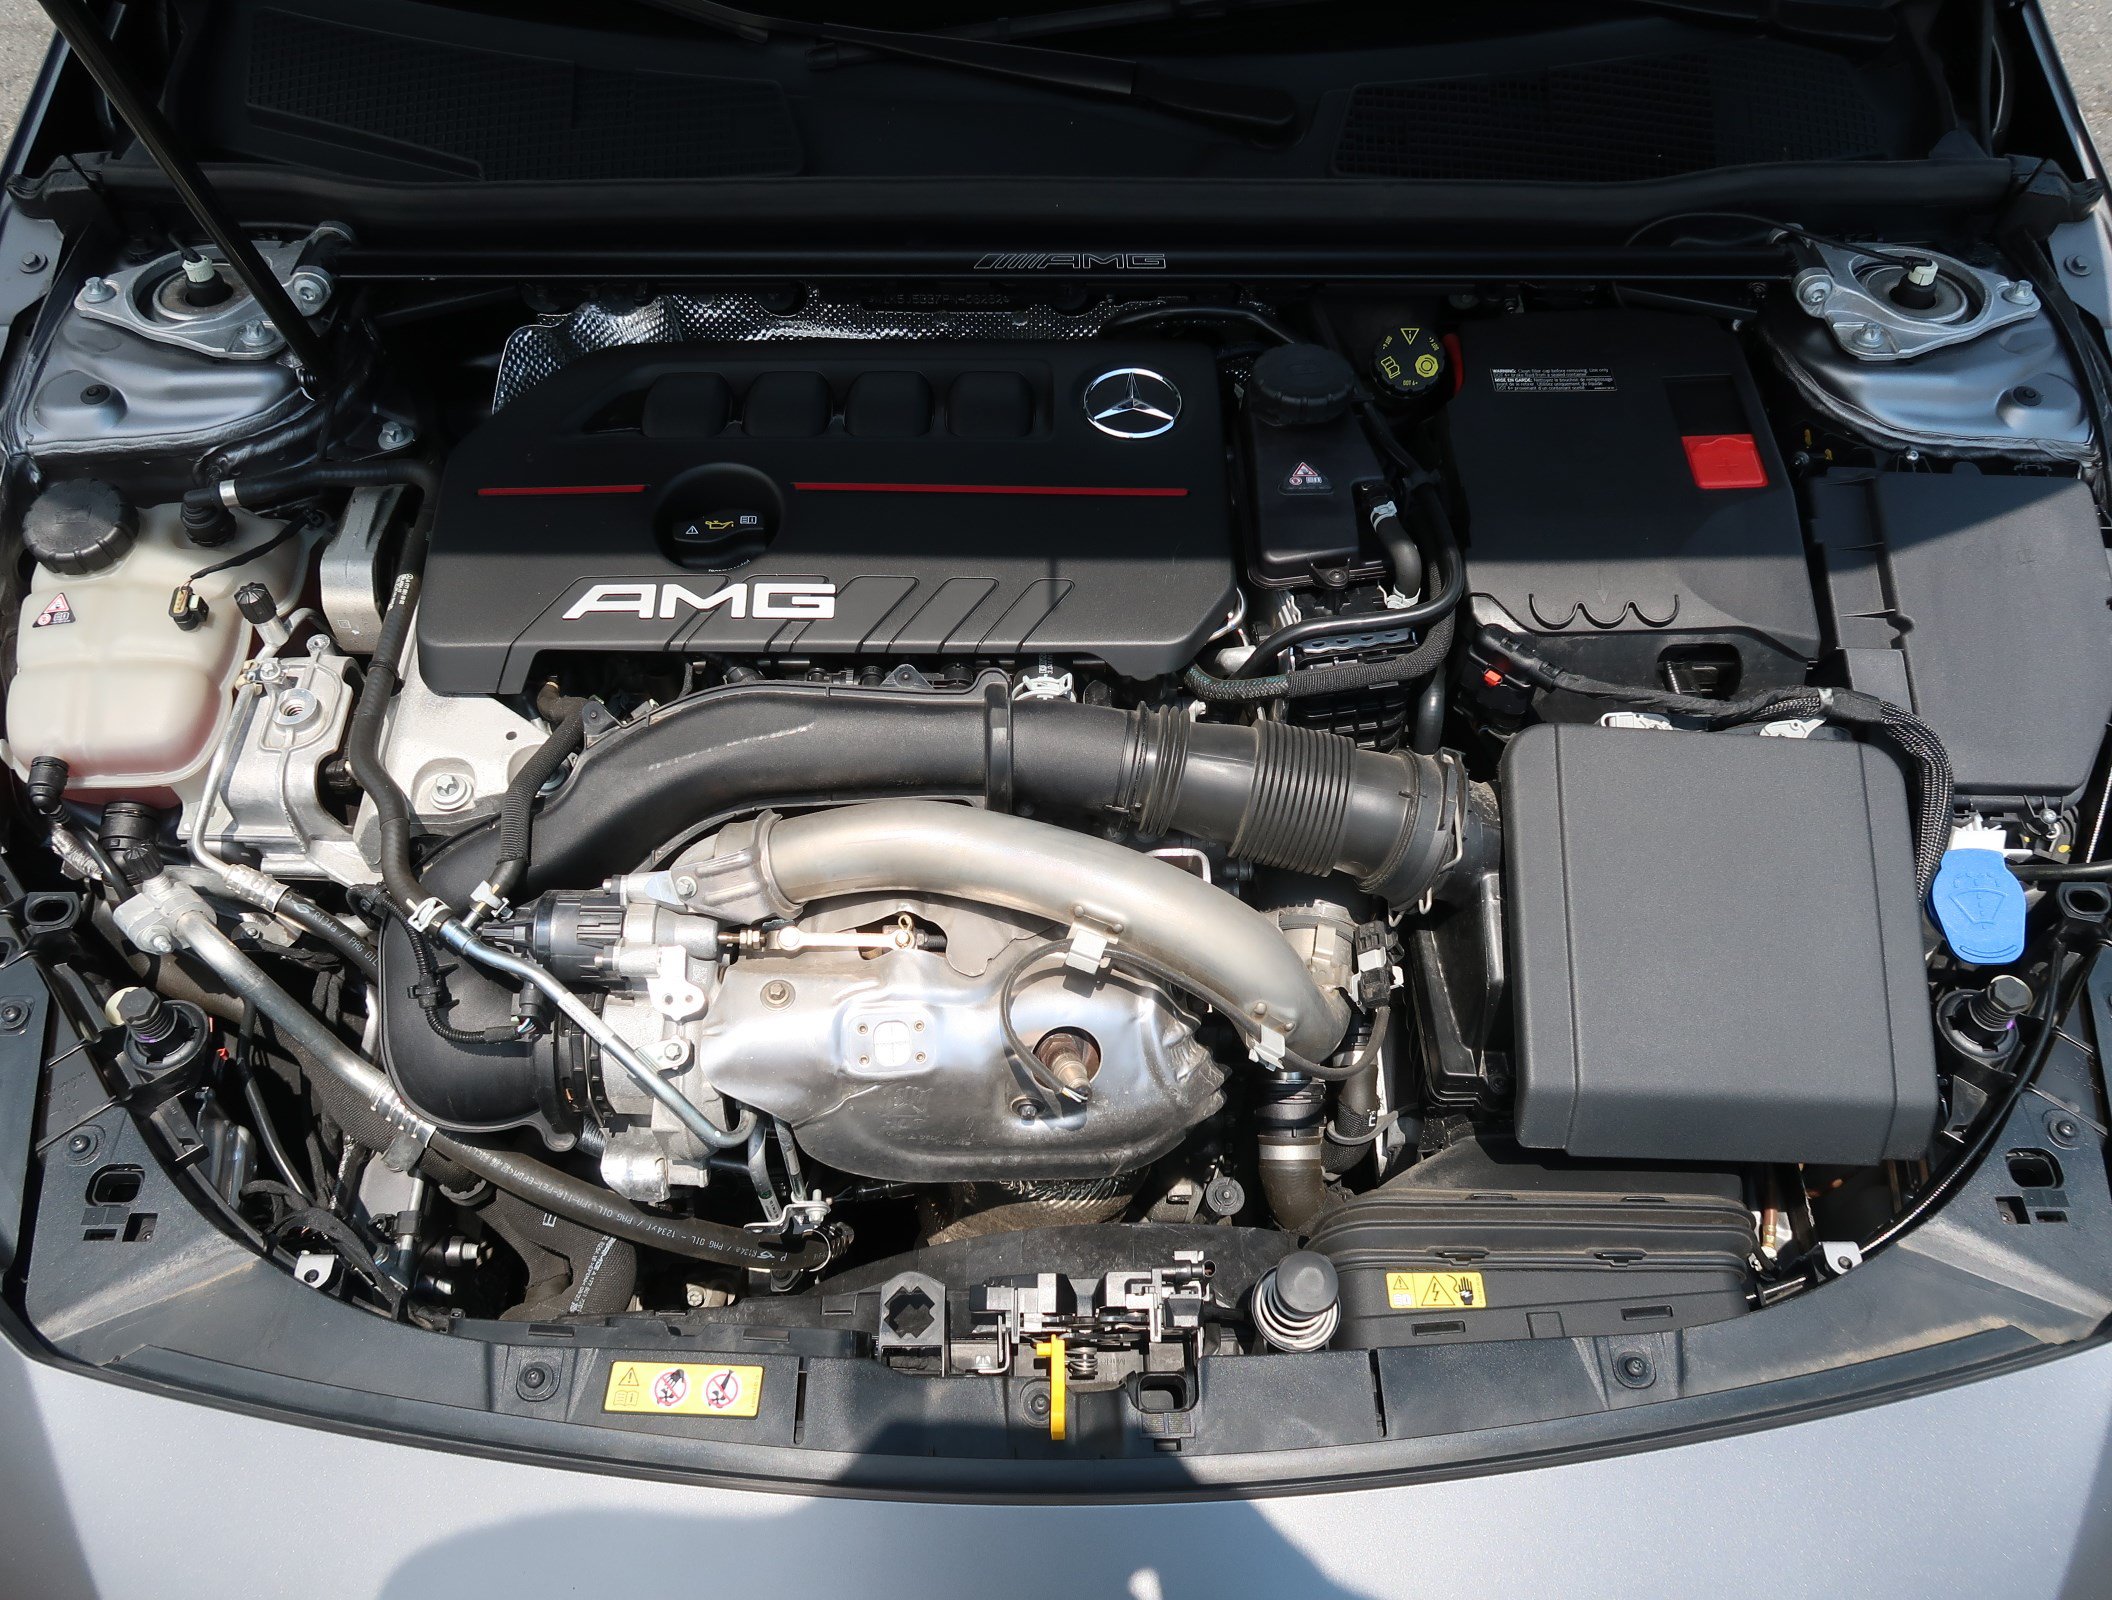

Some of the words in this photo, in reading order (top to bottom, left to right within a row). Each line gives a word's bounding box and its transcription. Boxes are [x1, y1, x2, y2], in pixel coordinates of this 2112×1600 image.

[1036, 252, 1168, 270] AMG
[562, 583, 836, 619] AMG
[312, 911, 338, 933] R134a
[348, 936, 366, 952] PAG
[598, 1204, 613, 1218] OIL
[616, 1213, 634, 1225] PAG
[692, 1235, 705, 1246] OIL
[709, 1240, 724, 1251] PAG
